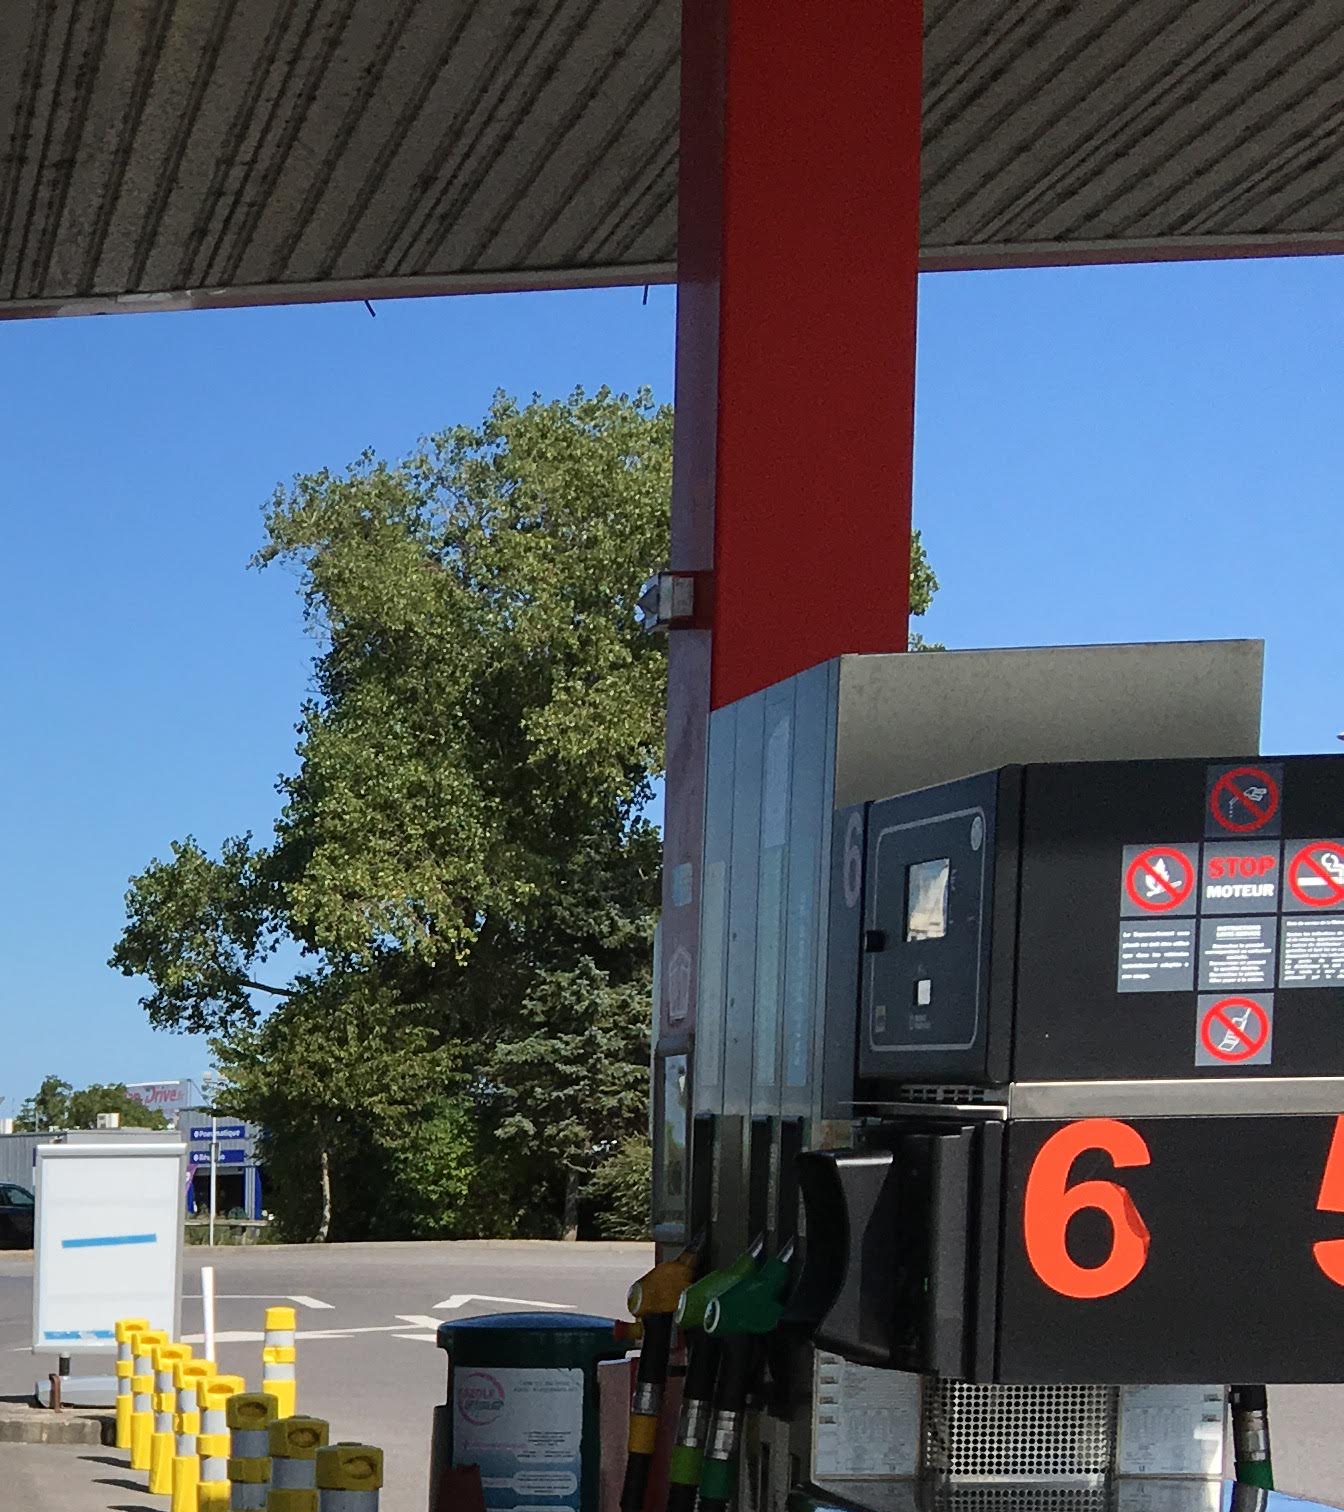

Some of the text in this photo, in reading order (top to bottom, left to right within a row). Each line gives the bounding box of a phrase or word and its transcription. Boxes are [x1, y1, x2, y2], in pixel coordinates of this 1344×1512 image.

[1208, 855, 1276, 878] STOP
[1206, 883, 1275, 898] MOTEUR
[1024, 1117, 1151, 1299] 6
